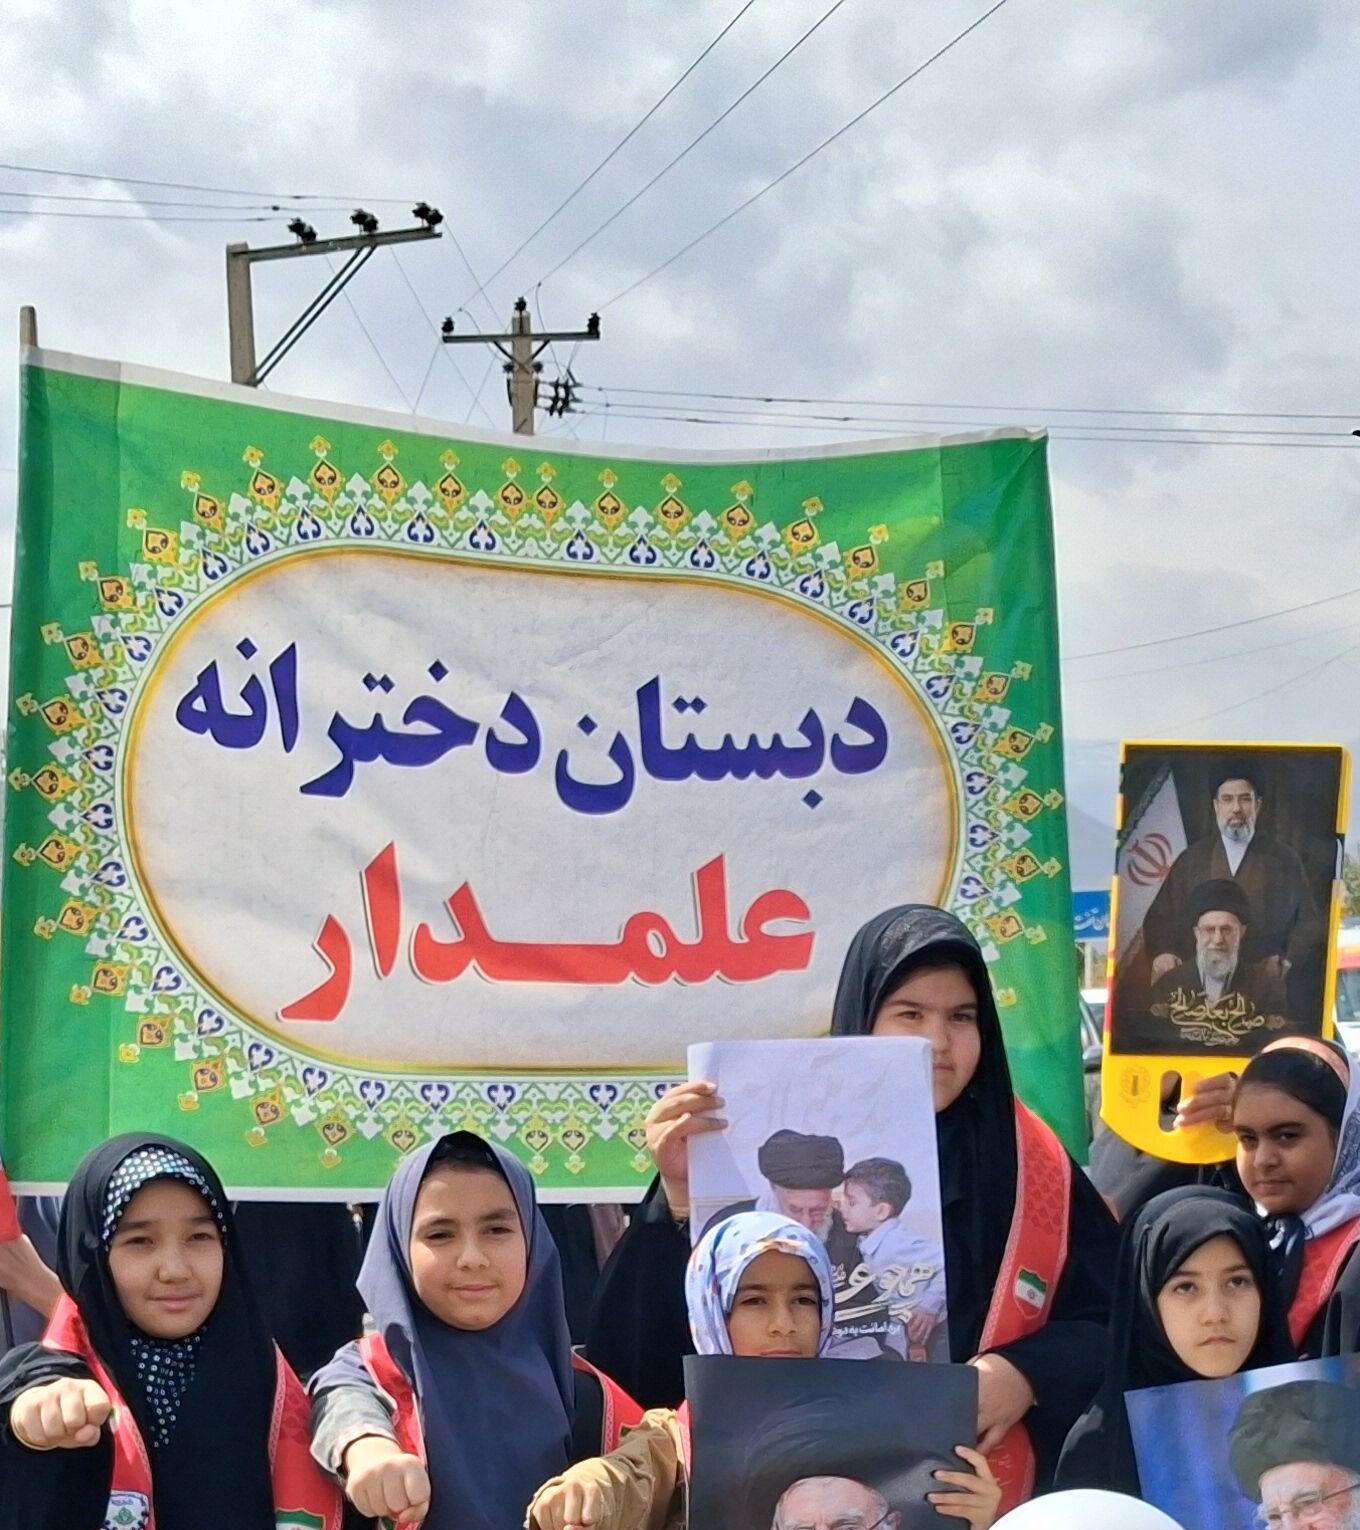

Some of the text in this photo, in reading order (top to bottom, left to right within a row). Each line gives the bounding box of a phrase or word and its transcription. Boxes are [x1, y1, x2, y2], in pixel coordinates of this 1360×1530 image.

[175, 637, 889, 817] دبستان دخترانه
[277, 839, 817, 1023] علمدار
